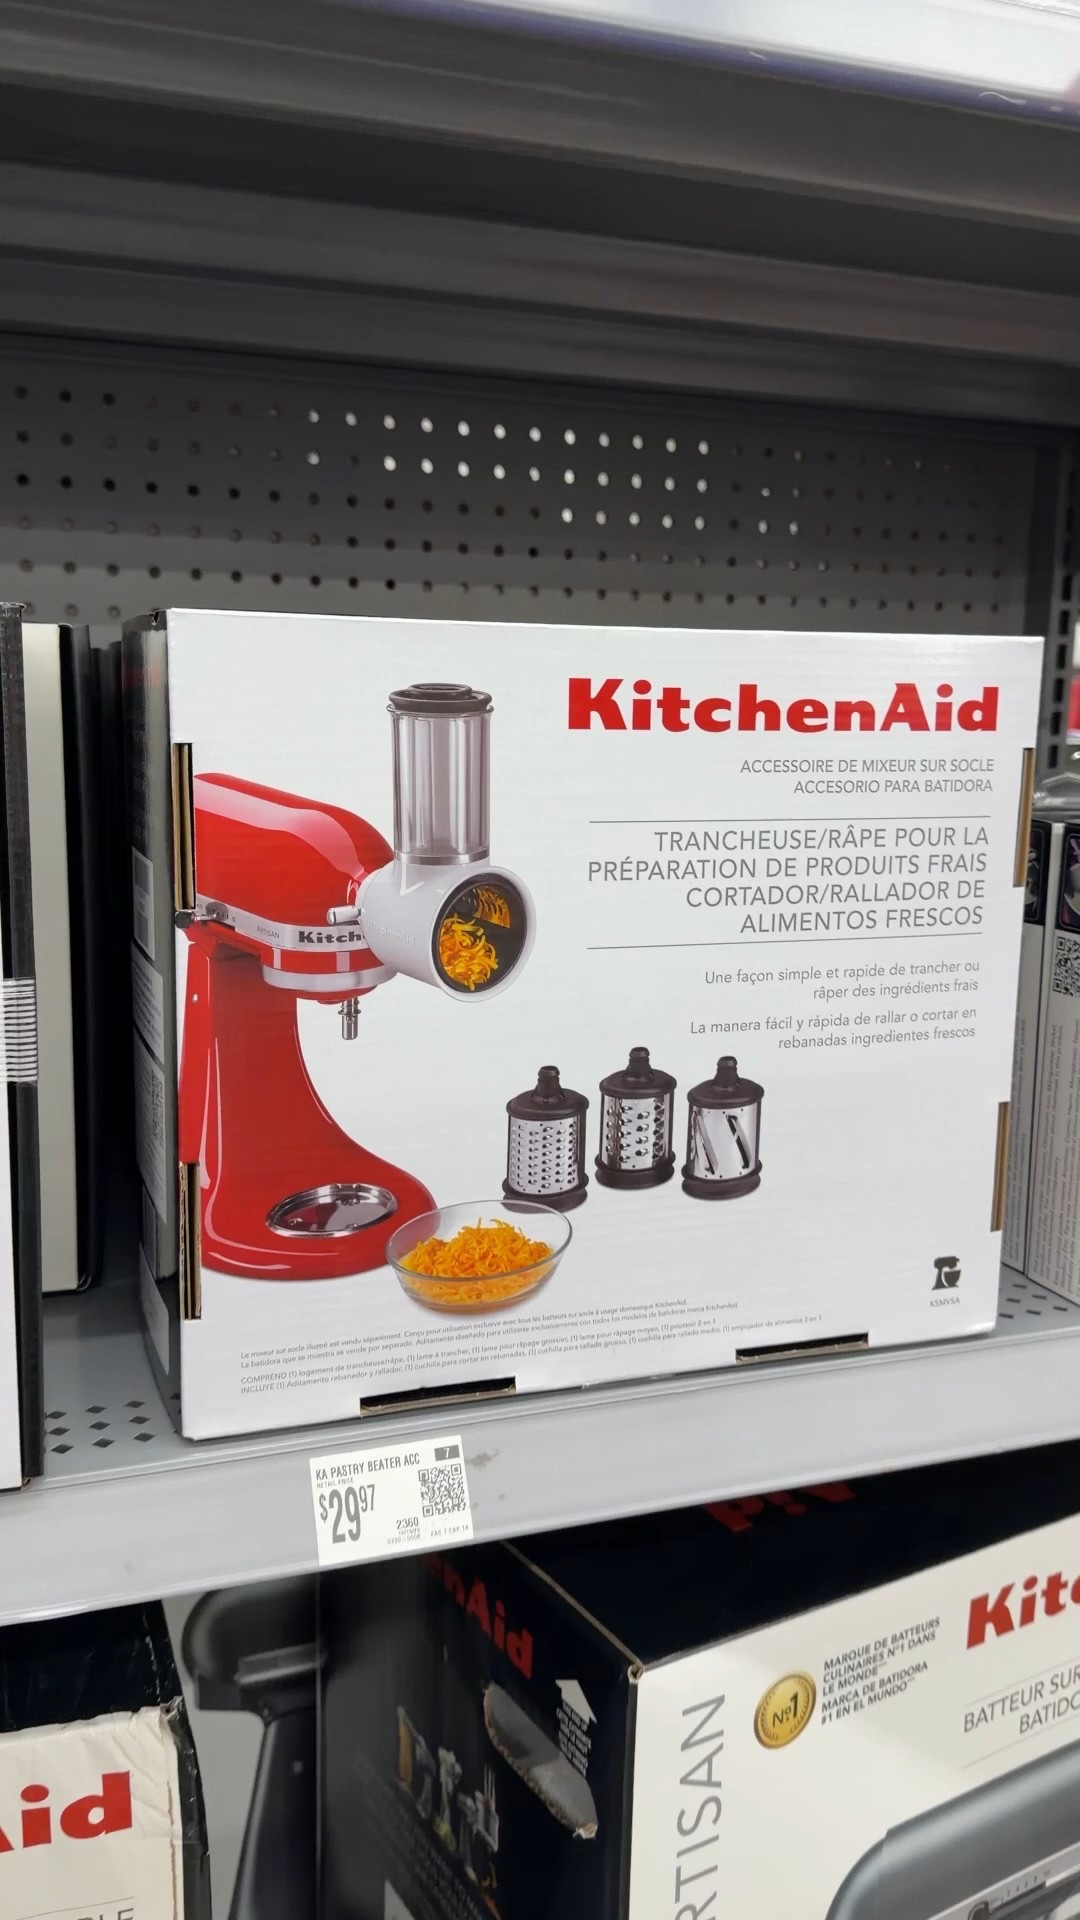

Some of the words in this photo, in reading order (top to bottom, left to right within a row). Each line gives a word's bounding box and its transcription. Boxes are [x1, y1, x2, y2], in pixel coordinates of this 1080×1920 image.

[568, 677, 999, 733] KitchenAid
[740, 760, 834, 774] ACCESSOIRE
[838, 760, 858, 772] DE
[862, 759, 916, 772] MIXEUR
[919, 759, 946, 772] SUR
[950, 759, 994, 772] SOCLE
[793, 780, 880, 794] ACCESORIO
[884, 780, 921, 793] PARA
[924, 779, 993, 792] BATIDORA
[654, 824, 886, 852] TRANCHEUSE/RÂPE
[894, 827, 956, 848] POUR
[963, 827, 989, 846] LA
[588, 854, 756, 882] PRÉPARATION
[766, 857, 797, 878] DE
[806, 855, 920, 876] PRODUITS
[928, 853, 987, 873] FRAIS
[686, 881, 950, 908] CORTADOR/RALLADOR
[957, 880, 986, 899] DE
[740, 910, 878, 934] ALIMENTOS
[886, 906, 983, 929] FRESCOS
[298, 930, 363, 944] Kitch
[705, 970, 732, 986] Une
[736, 969, 774, 986] façon
[778, 967, 822, 984] simple
[826, 967, 840, 980] et
[843, 964, 885, 983] rapide
[889, 963, 906, 977] de
[909, 961, 961, 976] trancher
[964, 962, 980, 973] ou
[813, 985, 848, 1002] râper
[852, 984, 876, 998] des
[880, 980, 948, 999] ingrédients
[953, 979, 979, 994] frais
[690, 1021, 707, 1035] La
[710, 1020, 760, 1035] manera
[764, 1016, 793, 1032] fácil
[797, 1018, 804, 1033] y
[808, 1013, 849, 1032] rápida
[853, 1012, 871, 1027] de
[874, 1010, 906, 1026] rallar
[910, 1013, 918, 1024] o
[922, 1008, 959, 1024] cortar
[962, 1008, 977, 1020] en
[778, 1032, 847, 1050] rebanadas
[851, 1028, 930, 1049] ingredientes
[933, 1025, 975, 1041] frescos
[306, 1342, 327, 1350] illustré
[340, 1338, 361, 1346] vendu
[425, 1329, 441, 1337] pour
[442, 1324, 472, 1333] utilisation
[541, 1313, 567, 1321] batteurs
[250, 1358, 280, 1367] batidora
[306, 1351, 335, 1359] muestra
[345, 1346, 367, 1354] vende
[486, 1330, 501, 1338] para
[298, 1366, 333, 1376] logement
[596, 1332, 612, 1340] pour
[240, 1383, 275, 1393] INCLUYE
[286, 1376, 329, 1387] Aditamento
[330, 1372, 367, 1381] rebanador
[441, 1360, 457, 1368] para
[316, 1468, 327, 1480] KA
[331, 1462, 364, 1478] PASTRY
[368, 1457, 401, 1472] BEATER
[404, 1453, 420, 1465] ACC
[444, 1448, 450, 1458] 7
[396, 1517, 419, 1530] 2360
[823, 1651, 884, 1684] CULINAIRES
[908, 1630, 936, 1650] DANS
[824, 1644, 871, 1671] MARQUE
[874, 1637, 888, 1651] DE
[891, 1616, 940, 1645] BATTEURS
[822, 1688, 859, 1713] MARCA
[862, 1682, 876, 1696] DE
[879, 1661, 928, 1689] BATIDORA
[823, 1682, 834, 1697] LE
[964, 1680, 1044, 1733] BATTEUR
[1050, 1664, 1080, 1695] SUR
[821, 1712, 832, 1725] #1
[836, 1705, 851, 1720] EN
[853, 1699, 865, 1712] EL
[0, 1771, 133, 1850] id
